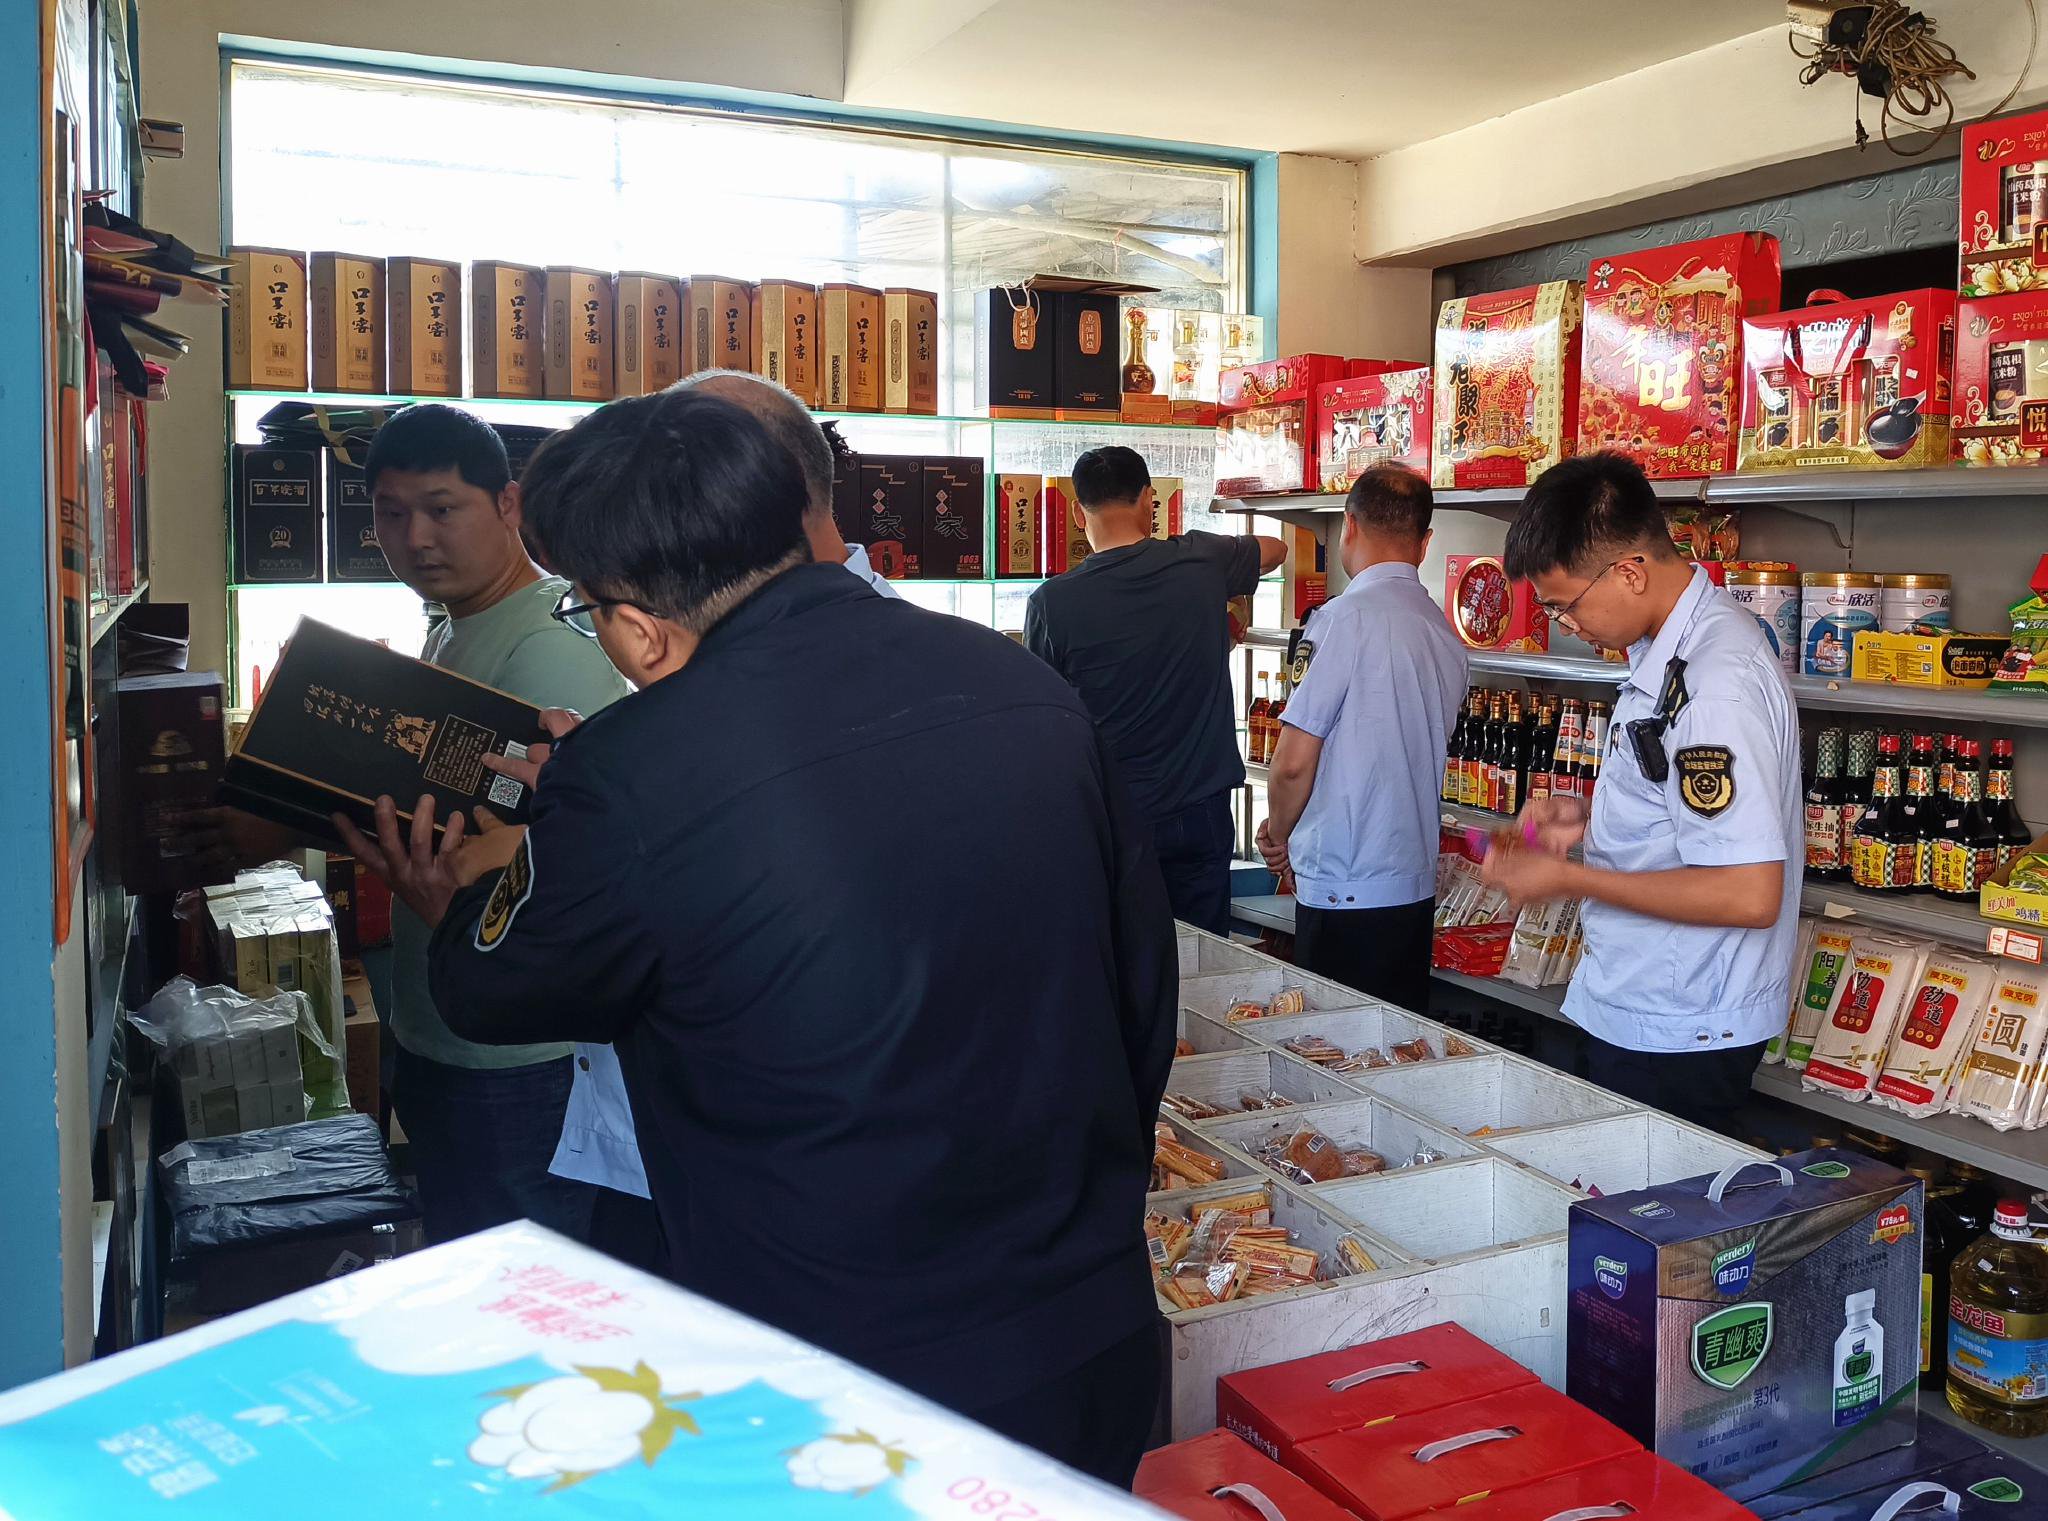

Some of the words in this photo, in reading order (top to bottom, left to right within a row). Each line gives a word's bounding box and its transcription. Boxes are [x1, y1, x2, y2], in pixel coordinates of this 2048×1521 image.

[268, 281, 289, 329] 口子窖
[351, 287, 371, 334] 口子窖
[426, 291, 446, 338] 口子窖
[510, 296, 527, 340] 口子窖
[584, 300, 600, 344] 口子窖
[654, 305, 668, 349] 口子窖
[725, 308, 740, 352] 口子窖
[793, 314, 806, 360] 口子窖
[856, 318, 869, 364] 口子窖
[916, 320, 929, 361] 口子窖
[1656, 441, 1710, 459] 把旺带回家
[1668, 458, 1723, 473] 我一定要旺
[871, 510, 906, 540] 家
[934, 511, 969, 540] 家
[1015, 498, 1028, 533] 口子窖
[273, 530, 287, 541] 20
[1847, 593, 1877, 607] 欣活
[1679, 750, 1728, 761] 中华人民共和国
[2015, 907, 2041, 921] 鸡精
[1818, 951, 1838, 989] 阳春
[1923, 985, 1947, 1026] 劲道
[1991, 1011, 2028, 1054] 圆
[1996, 1214, 2016, 1226] 金龙鱼
[1597, 1259, 1626, 1274] werdery
[1716, 1241, 1753, 1264] werdery
[1600, 1271, 1623, 1292] 味动力
[1718, 1263, 1749, 1286] 味动力
[1950, 1295, 2005, 1337] 金龙鱼
[1703, 1320, 1767, 1370] 青幽爽
[1753, 1382, 1780, 1409] 第3代
